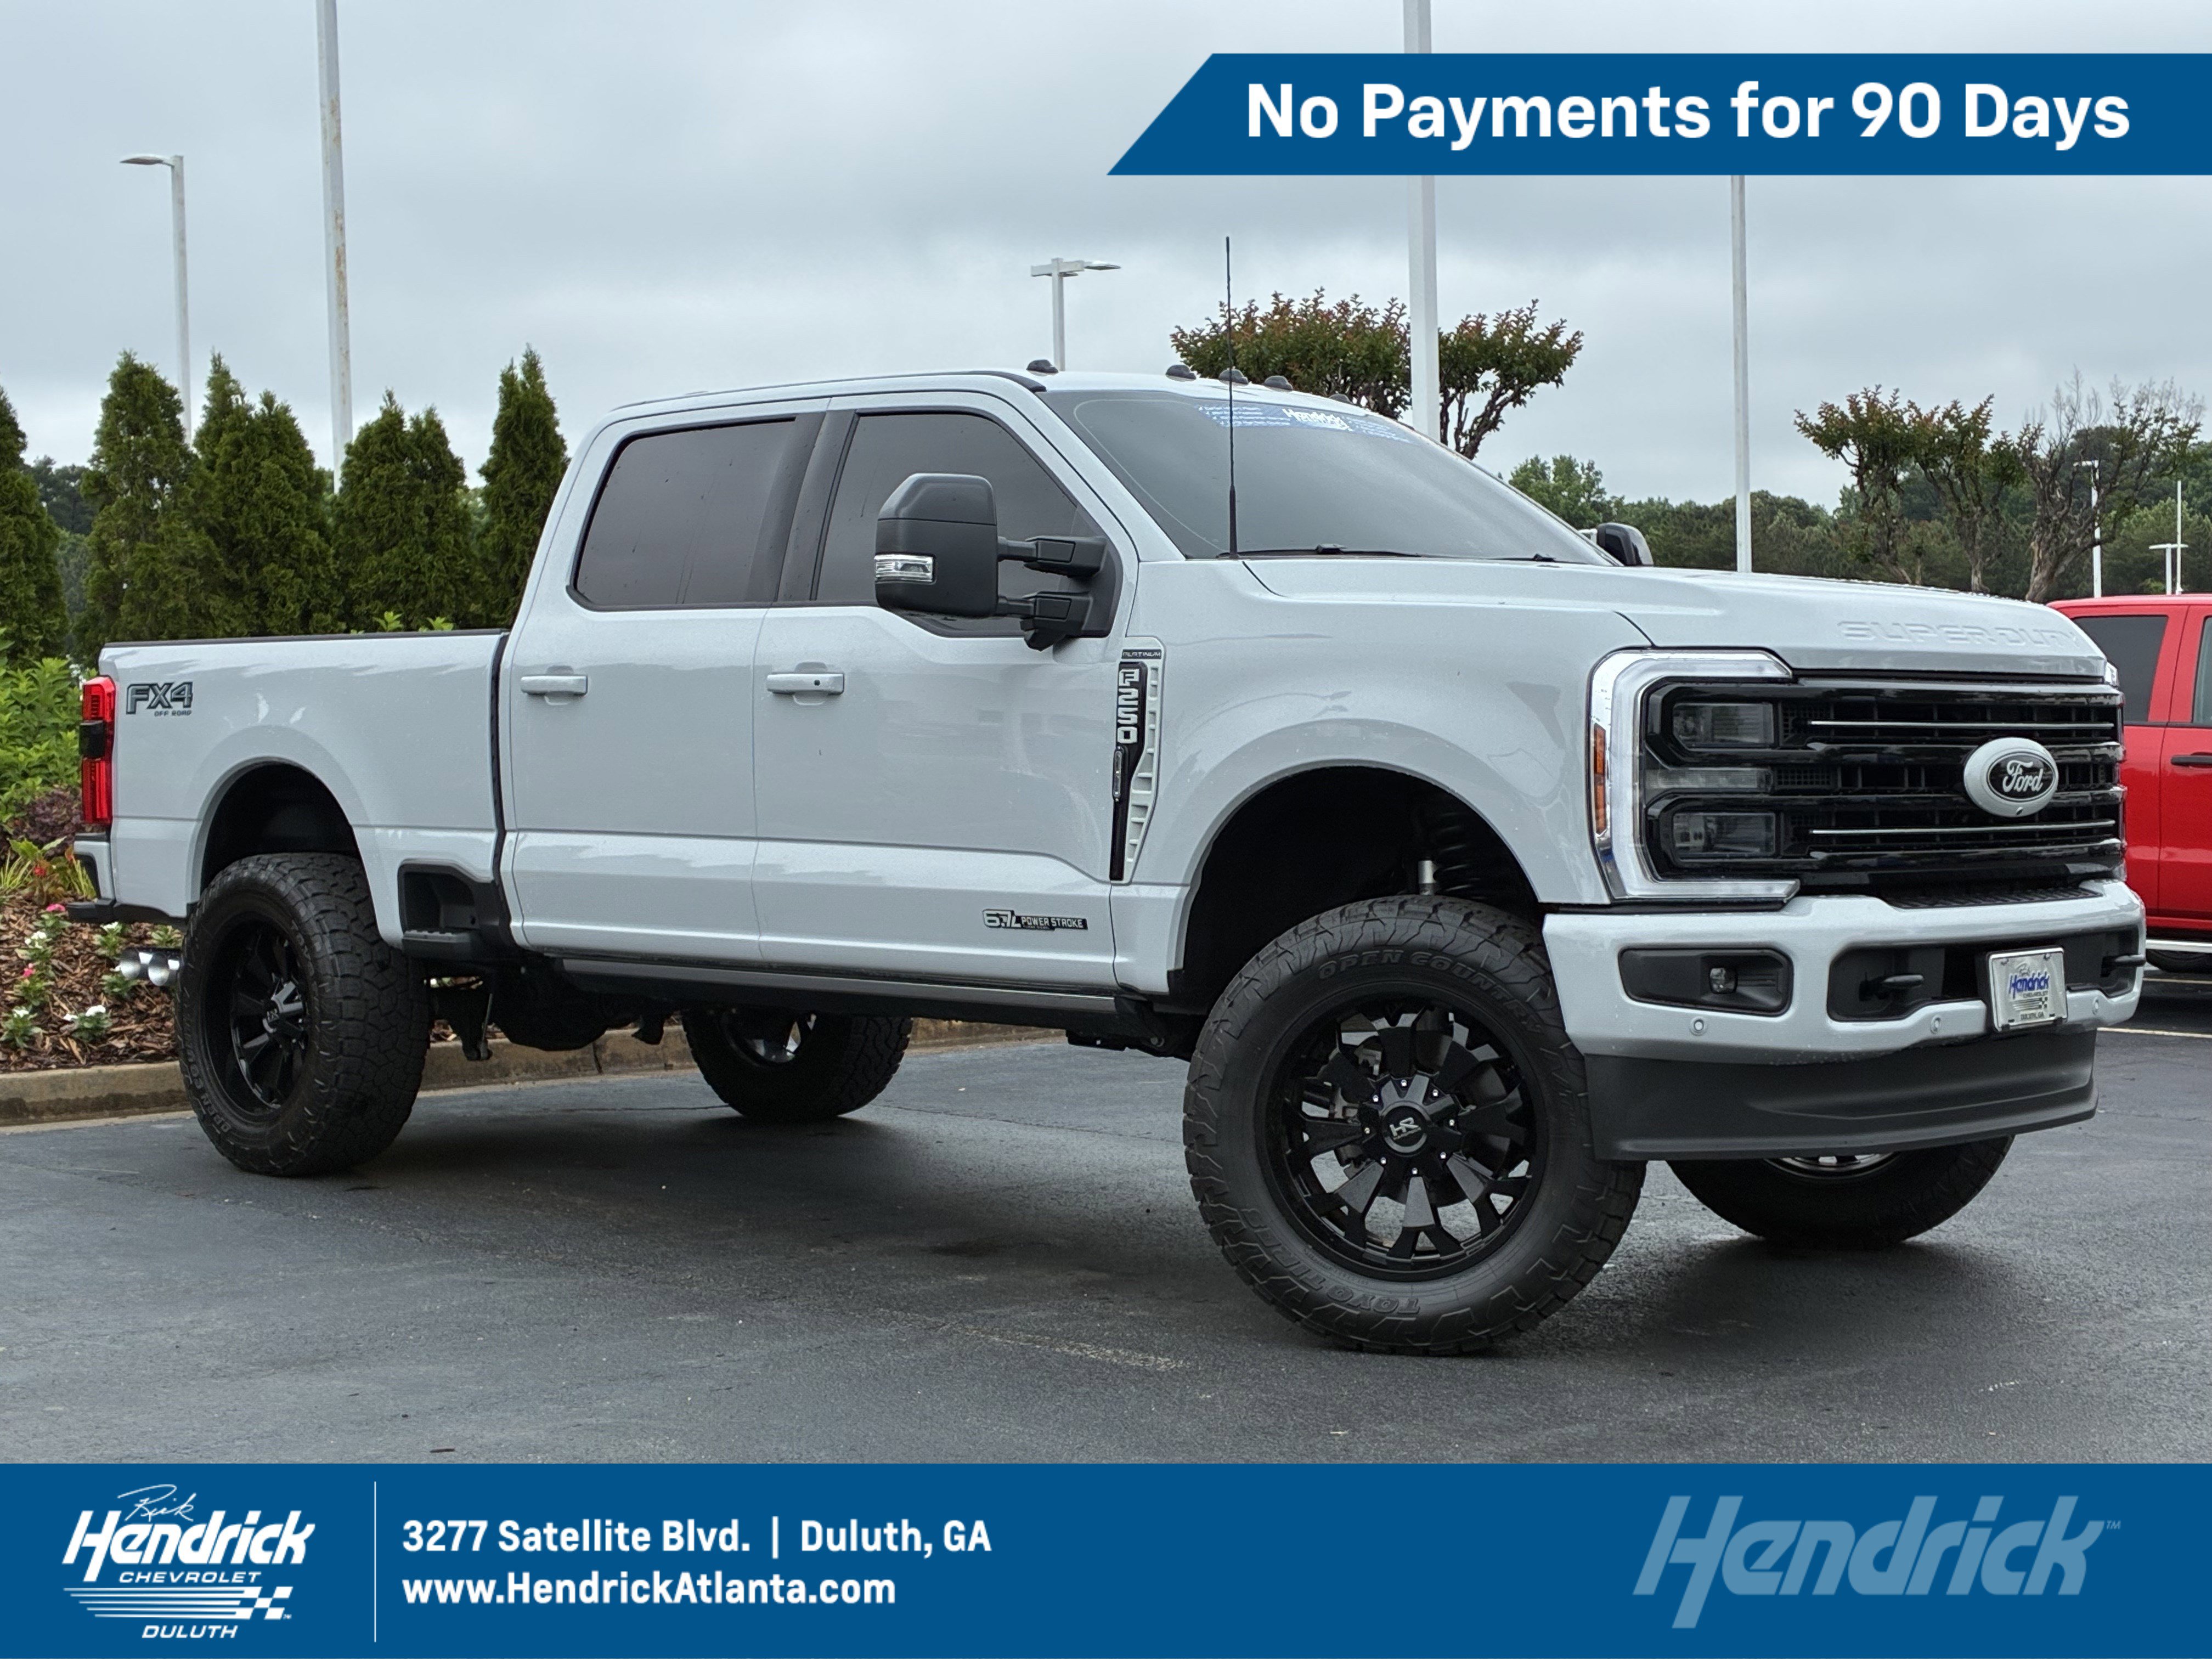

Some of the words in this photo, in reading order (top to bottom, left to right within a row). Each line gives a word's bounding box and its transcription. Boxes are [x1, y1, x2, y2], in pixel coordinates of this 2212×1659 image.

[126, 681, 193, 714] FX4
[2002, 760, 2044, 792] Ford
[983, 910, 1021, 928] 6.7L
[1021, 916, 1050, 926] POWER
[1049, 918, 1083, 928] STROKE
[1318, 949, 1404, 980] OPEN
[1327, 1284, 1420, 1314] TOYO
